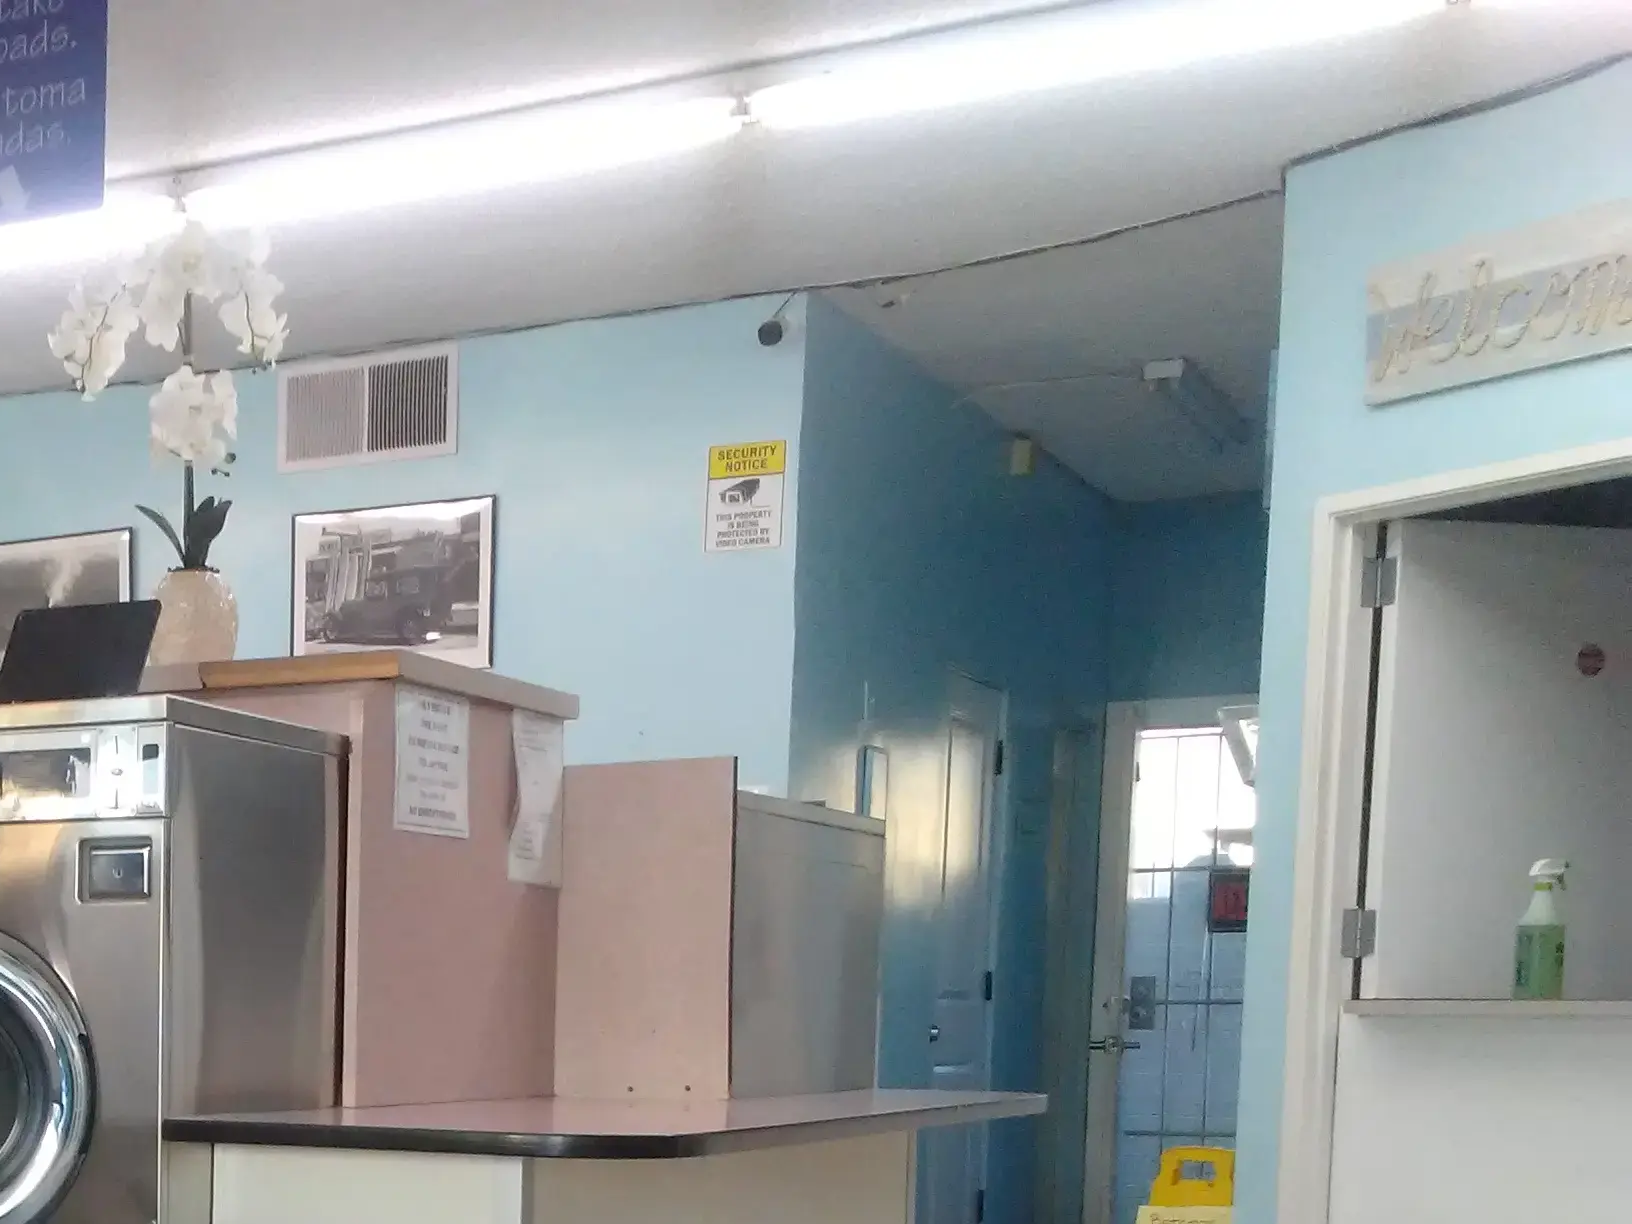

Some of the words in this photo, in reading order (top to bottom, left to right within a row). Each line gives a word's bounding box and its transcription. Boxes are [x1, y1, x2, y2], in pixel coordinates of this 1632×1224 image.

[3, 77, 88, 119] toma
[717, 445, 776, 460] SECURITY
[725, 459, 768, 472] NOTICE
